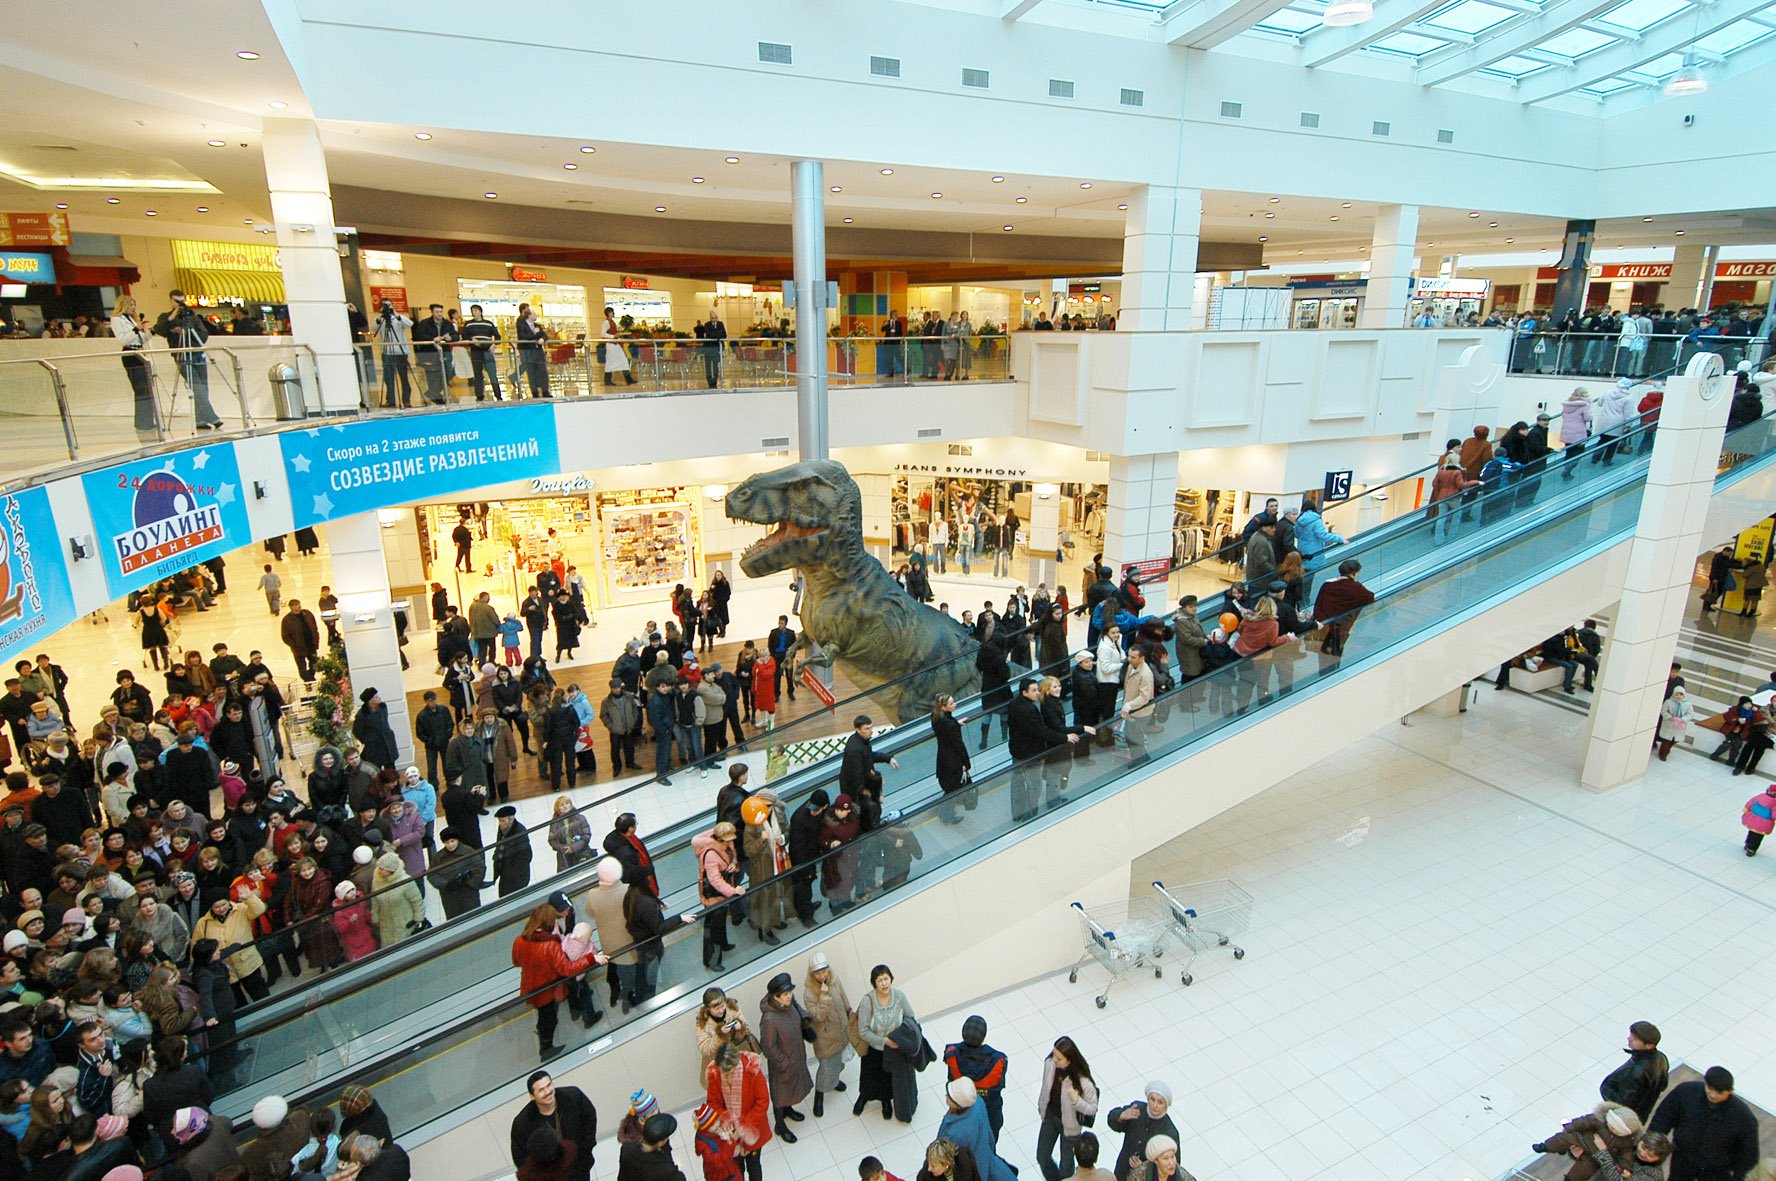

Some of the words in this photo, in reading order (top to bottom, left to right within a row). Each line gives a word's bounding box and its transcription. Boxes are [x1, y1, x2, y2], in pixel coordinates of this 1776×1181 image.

[1617, 265, 1672, 277] книж
[327, 445, 363, 461] Скоро
[365, 443, 379, 455] на
[381, 439, 389, 453] 2
[392, 437, 426, 451] этаже
[429, 430, 479, 446] появится
[330, 457, 425, 492] СОЗВЕЗДИЕ
[429, 437, 539, 473] РАЗВЛЕЧЕНИЙ
[894, 464, 937, 472] JEANS
[946, 466, 1026, 476] SYMPHONY
[118, 473, 141, 490] 24
[529, 472, 595, 496] Douglas
[116, 507, 216, 559] БОУЛИНГ
[124, 528, 221, 571] ПЛАНЕТА
[156, 551, 199, 576] БИЛЬЯРД
[24, 613, 47, 635] КУХНЯ
